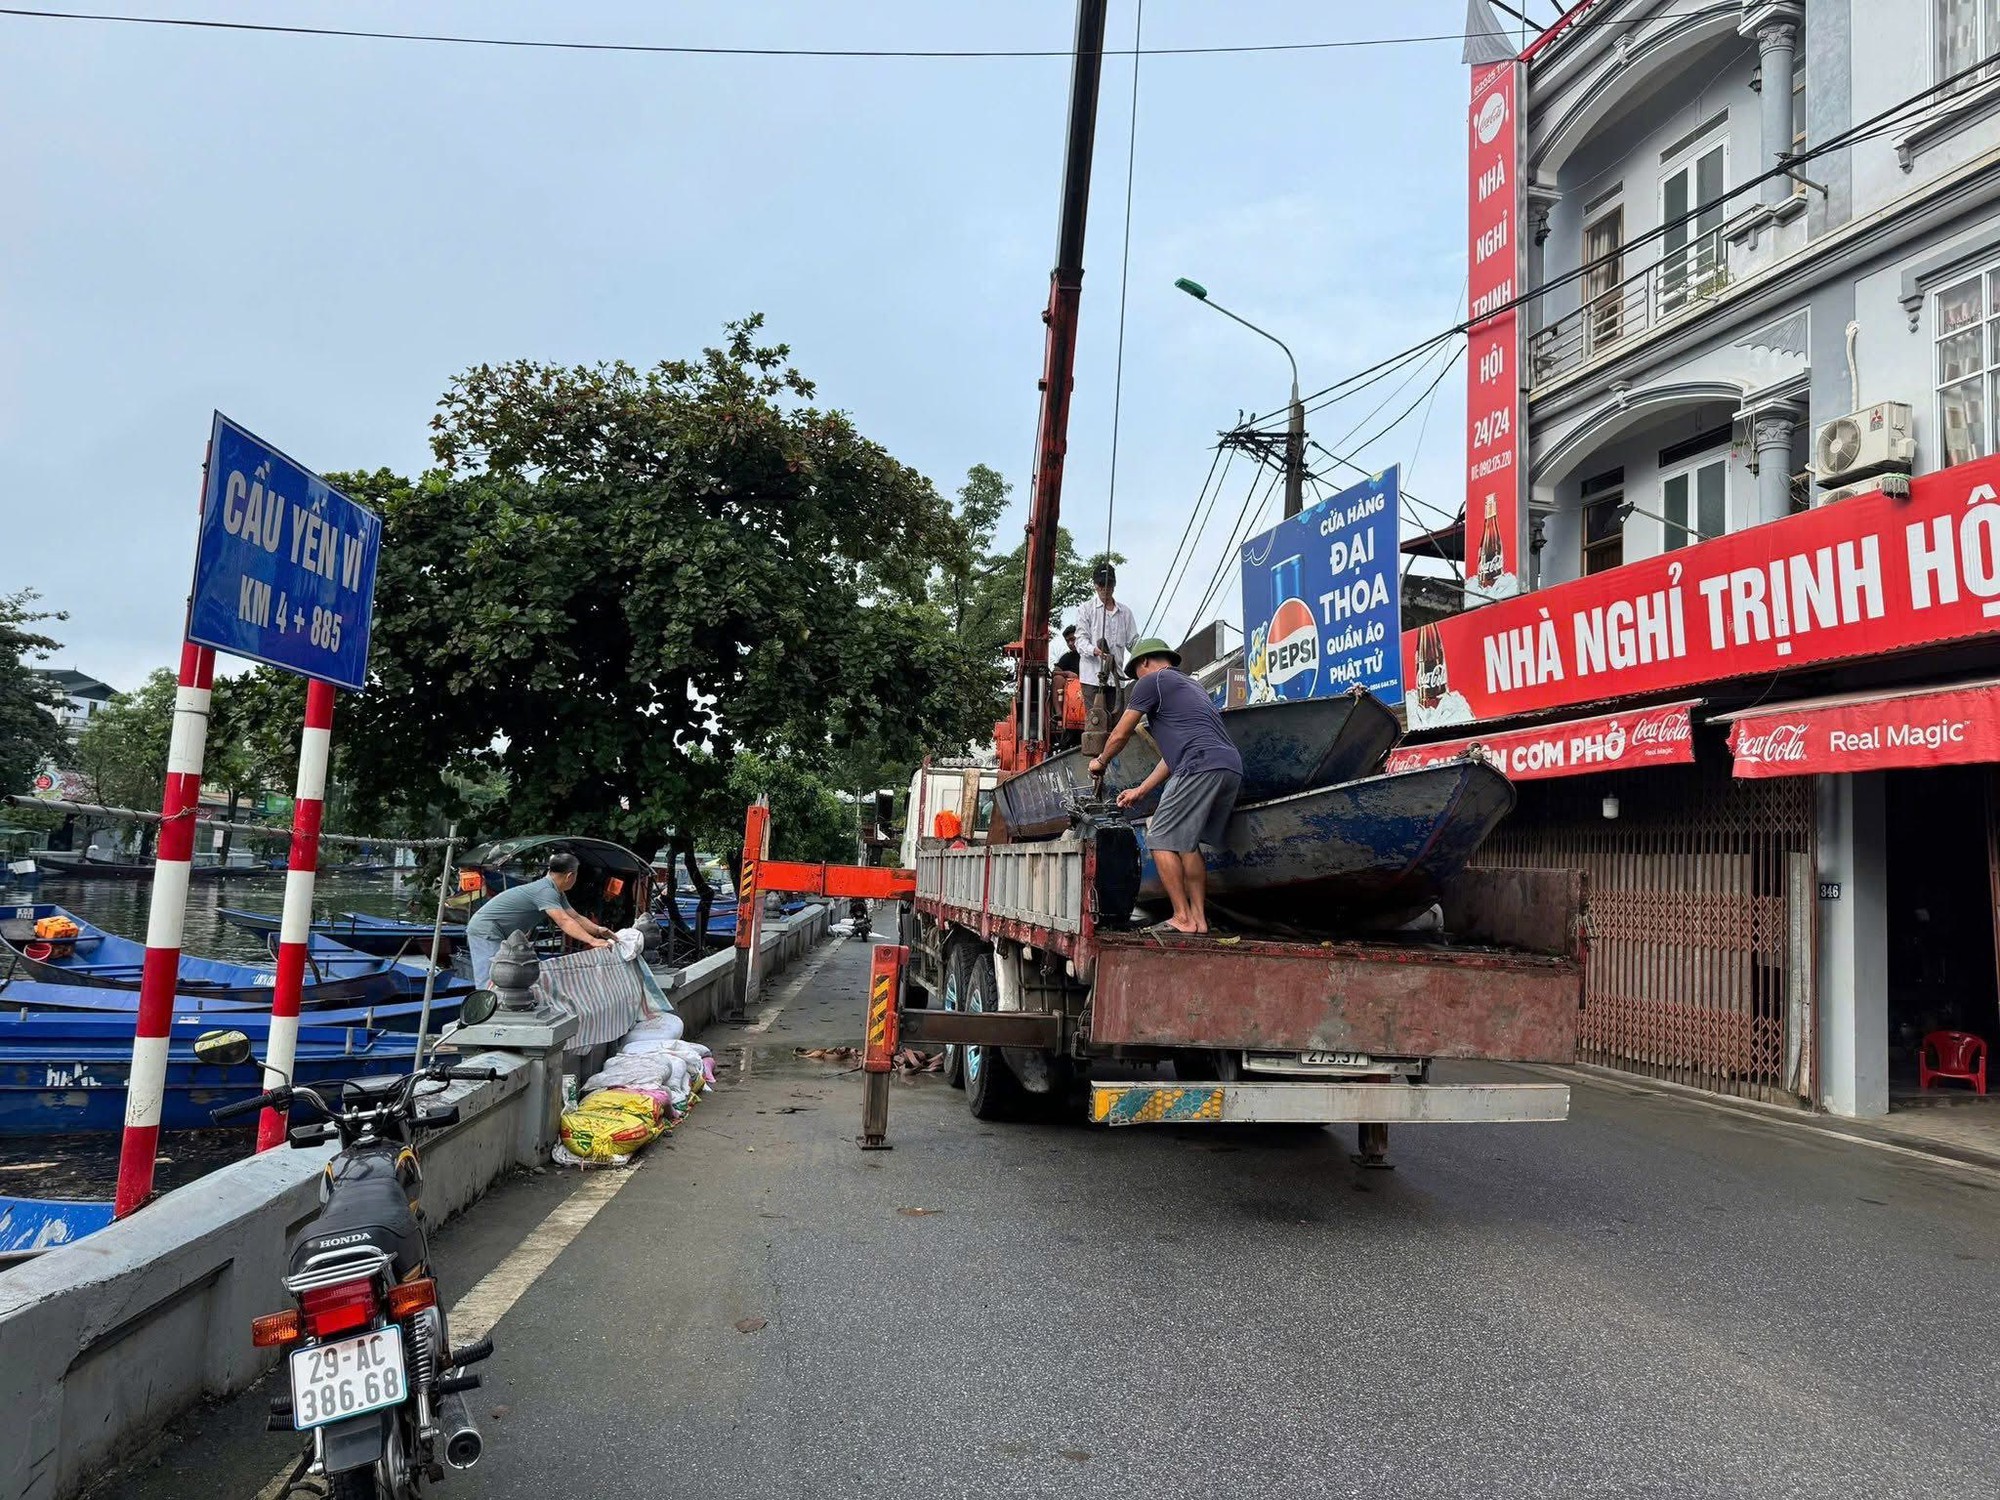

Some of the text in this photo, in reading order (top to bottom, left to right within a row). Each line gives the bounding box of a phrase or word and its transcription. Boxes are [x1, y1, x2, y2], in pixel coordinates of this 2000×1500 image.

[1478, 153, 1505, 203] NHÀ
[1476, 209, 1508, 265] NGHỈ
[1472, 278, 1511, 325] TRỊNH
[1480, 342, 1504, 385] HỘI
[1473, 406, 1510, 449] 24/24
[223, 461, 285, 553] CẦU
[290, 498, 339, 581] YẾN
[1320, 493, 1385, 537] CỬA HÀNG
[1329, 527, 1375, 576] ĐẠI
[238, 574, 272, 629] KM
[275, 591, 288, 634] 4
[310, 605, 343, 653] 885
[1319, 572, 1390, 625] THOA
[1483, 607, 1565, 695] NHÀ
[1573, 562, 1687, 677] NGHỈ
[1699, 534, 1885, 656] TRỊNH
[1268, 637, 1316, 673] PEPSI
[1326, 620, 1385, 655] QUẦN ÁO
[1329, 647, 1384, 684] PHẬT TỬ
[1511, 739, 1564, 772] CƠM
[1569, 720, 1627, 765] PHỞ
[1632, 713, 1690, 745] Coca-Cola
[1829, 727, 1879, 752] Real
[1820, 884, 1839, 898] 346
[319, 1232, 372, 1249] HONDA
[307, 1335, 386, 1385] 29-AC
[301, 1367, 399, 1422] 386.68
